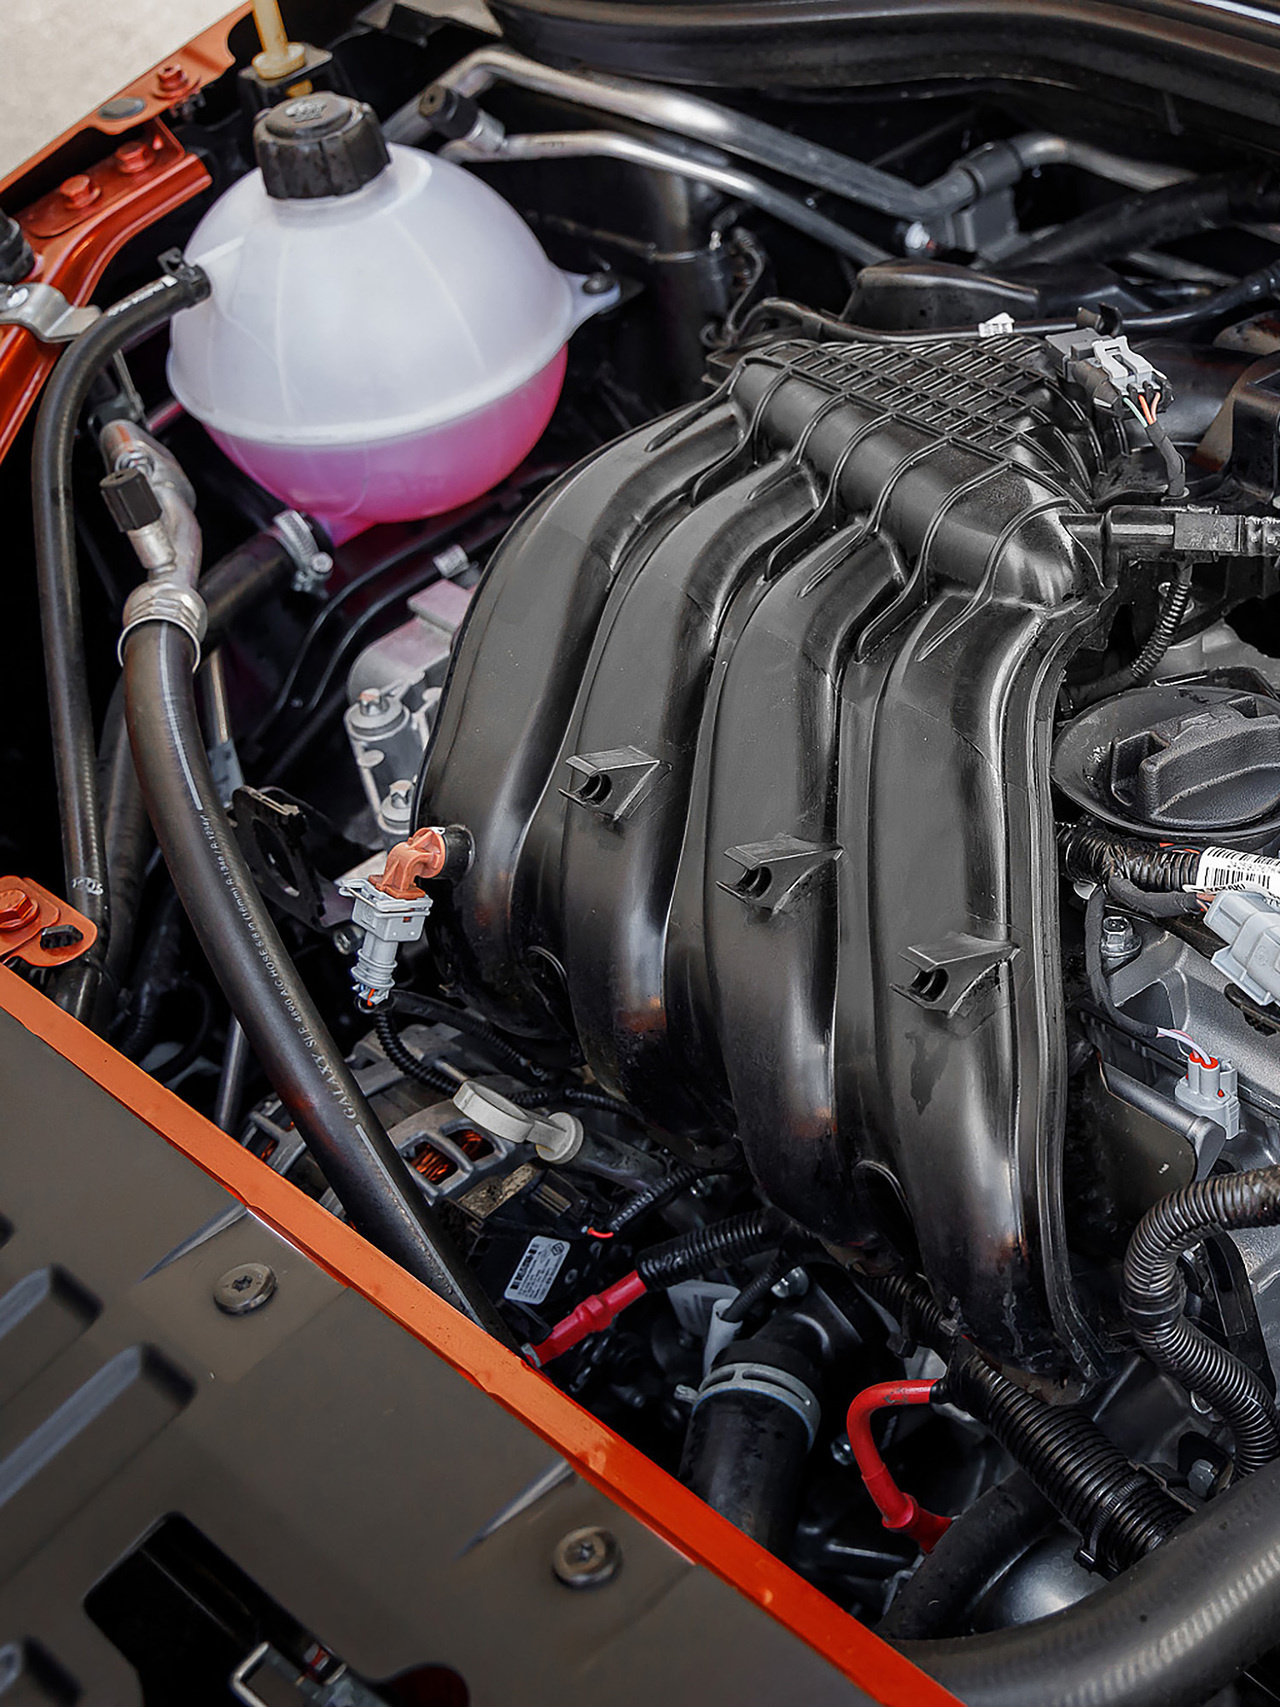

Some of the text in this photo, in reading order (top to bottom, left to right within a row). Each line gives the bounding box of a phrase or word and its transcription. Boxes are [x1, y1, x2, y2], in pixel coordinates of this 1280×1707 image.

[258, 948, 278, 978] HOSE
[297, 1026, 317, 1048] SLE
[311, 1052, 357, 1119] GALAXY
